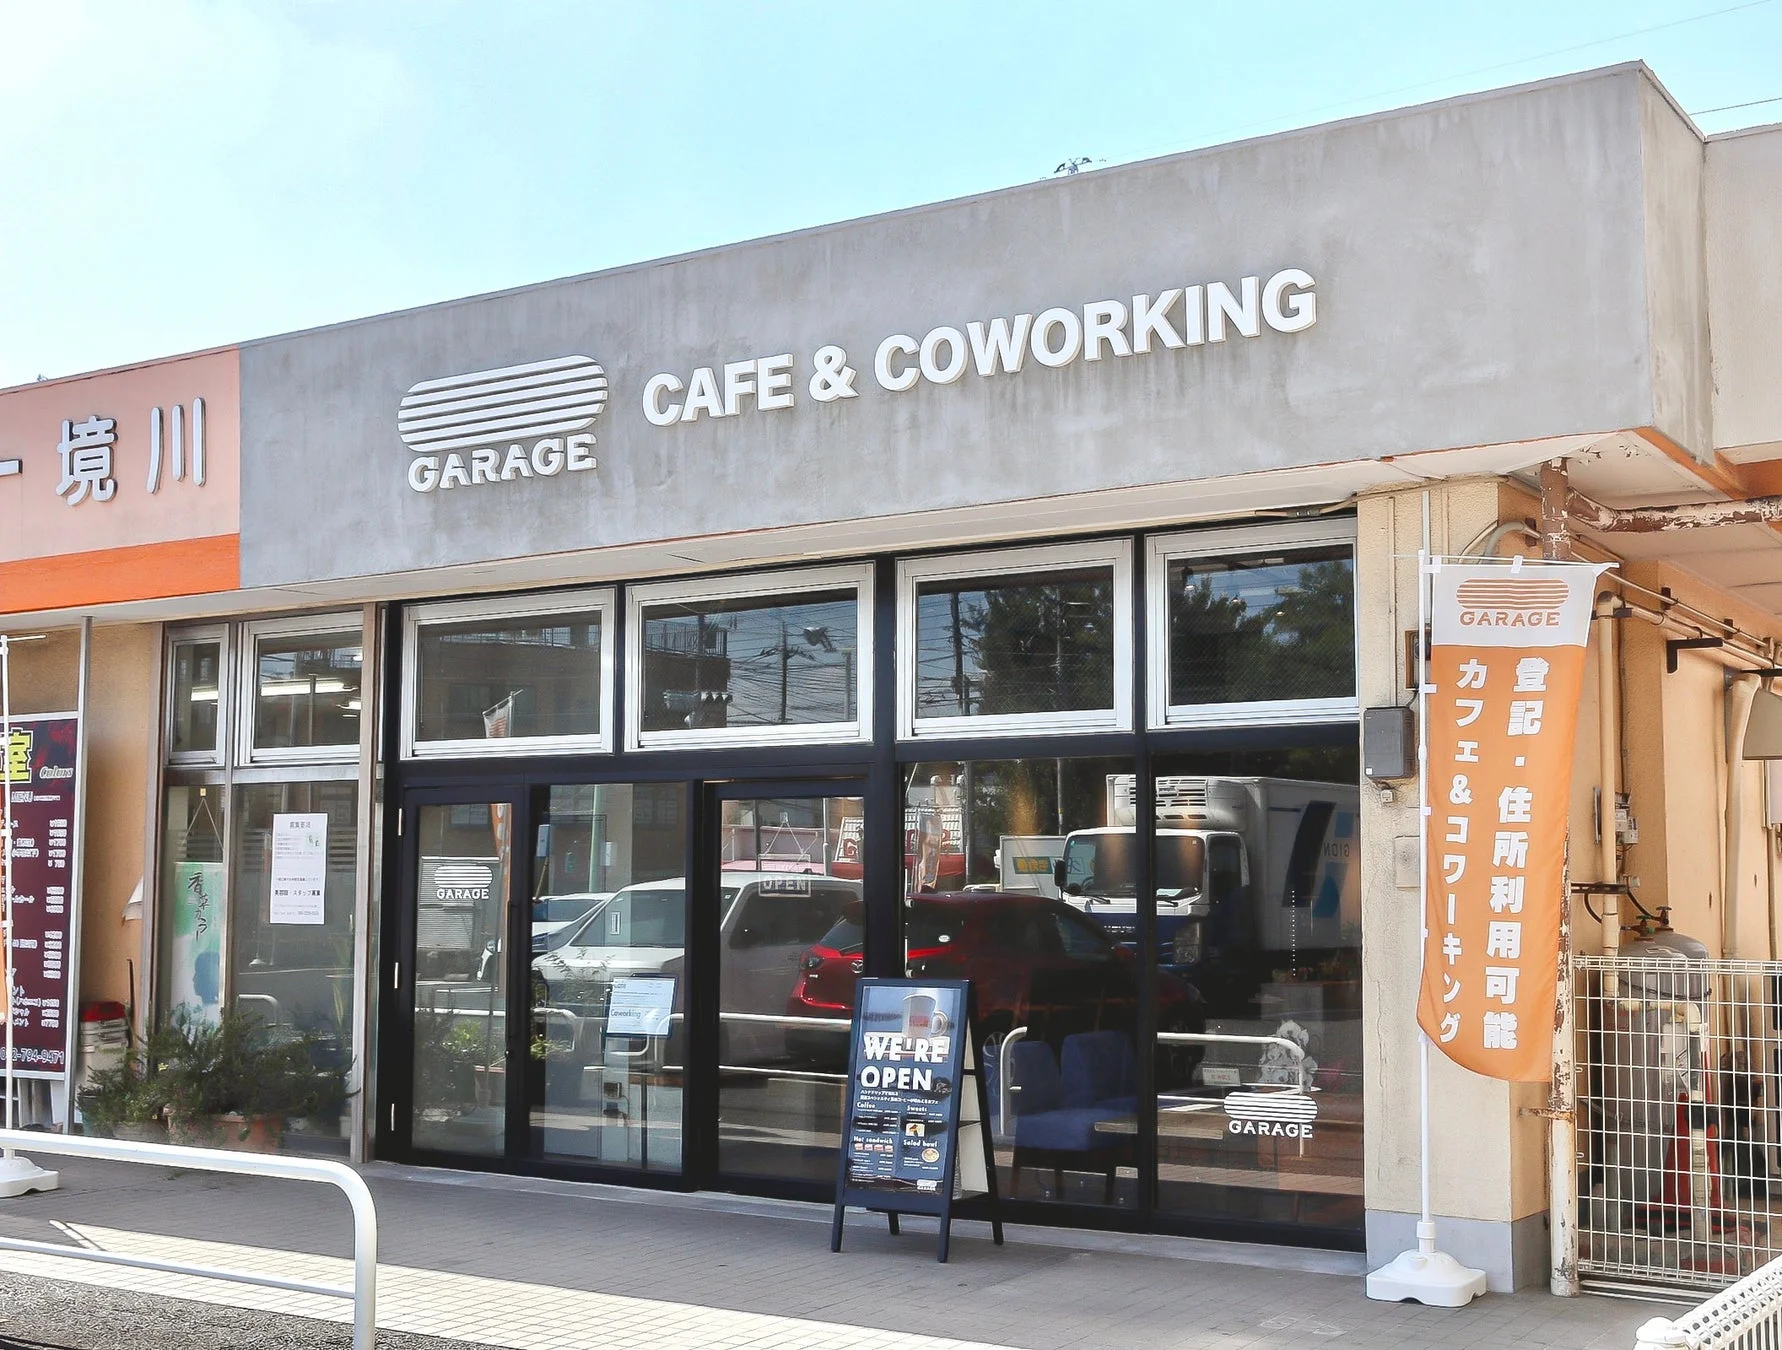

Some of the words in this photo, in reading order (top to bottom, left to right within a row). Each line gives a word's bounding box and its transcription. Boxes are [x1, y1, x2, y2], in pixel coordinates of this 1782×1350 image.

[642, 353, 795, 428] CAFE
[808, 344, 860, 403] &
[873, 268, 1318, 392] COWORKING
[407, 432, 598, 494] GARAGE
[1459, 610, 1561, 628] GARAGE
[1439, 658, 1488, 1043] カフェ&コワーキング
[1482, 656, 1550, 1050] 登記・住所利用可能
[763, 876, 806, 891] OPEN
[436, 888, 490, 900] GARAGE
[0, 1046, 65, 1065] 02-794-9471
[860, 1065, 932, 1091] OPEN
[856, 1101, 876, 1109] Coffee
[1228, 1120, 1314, 1139] GARAGE
